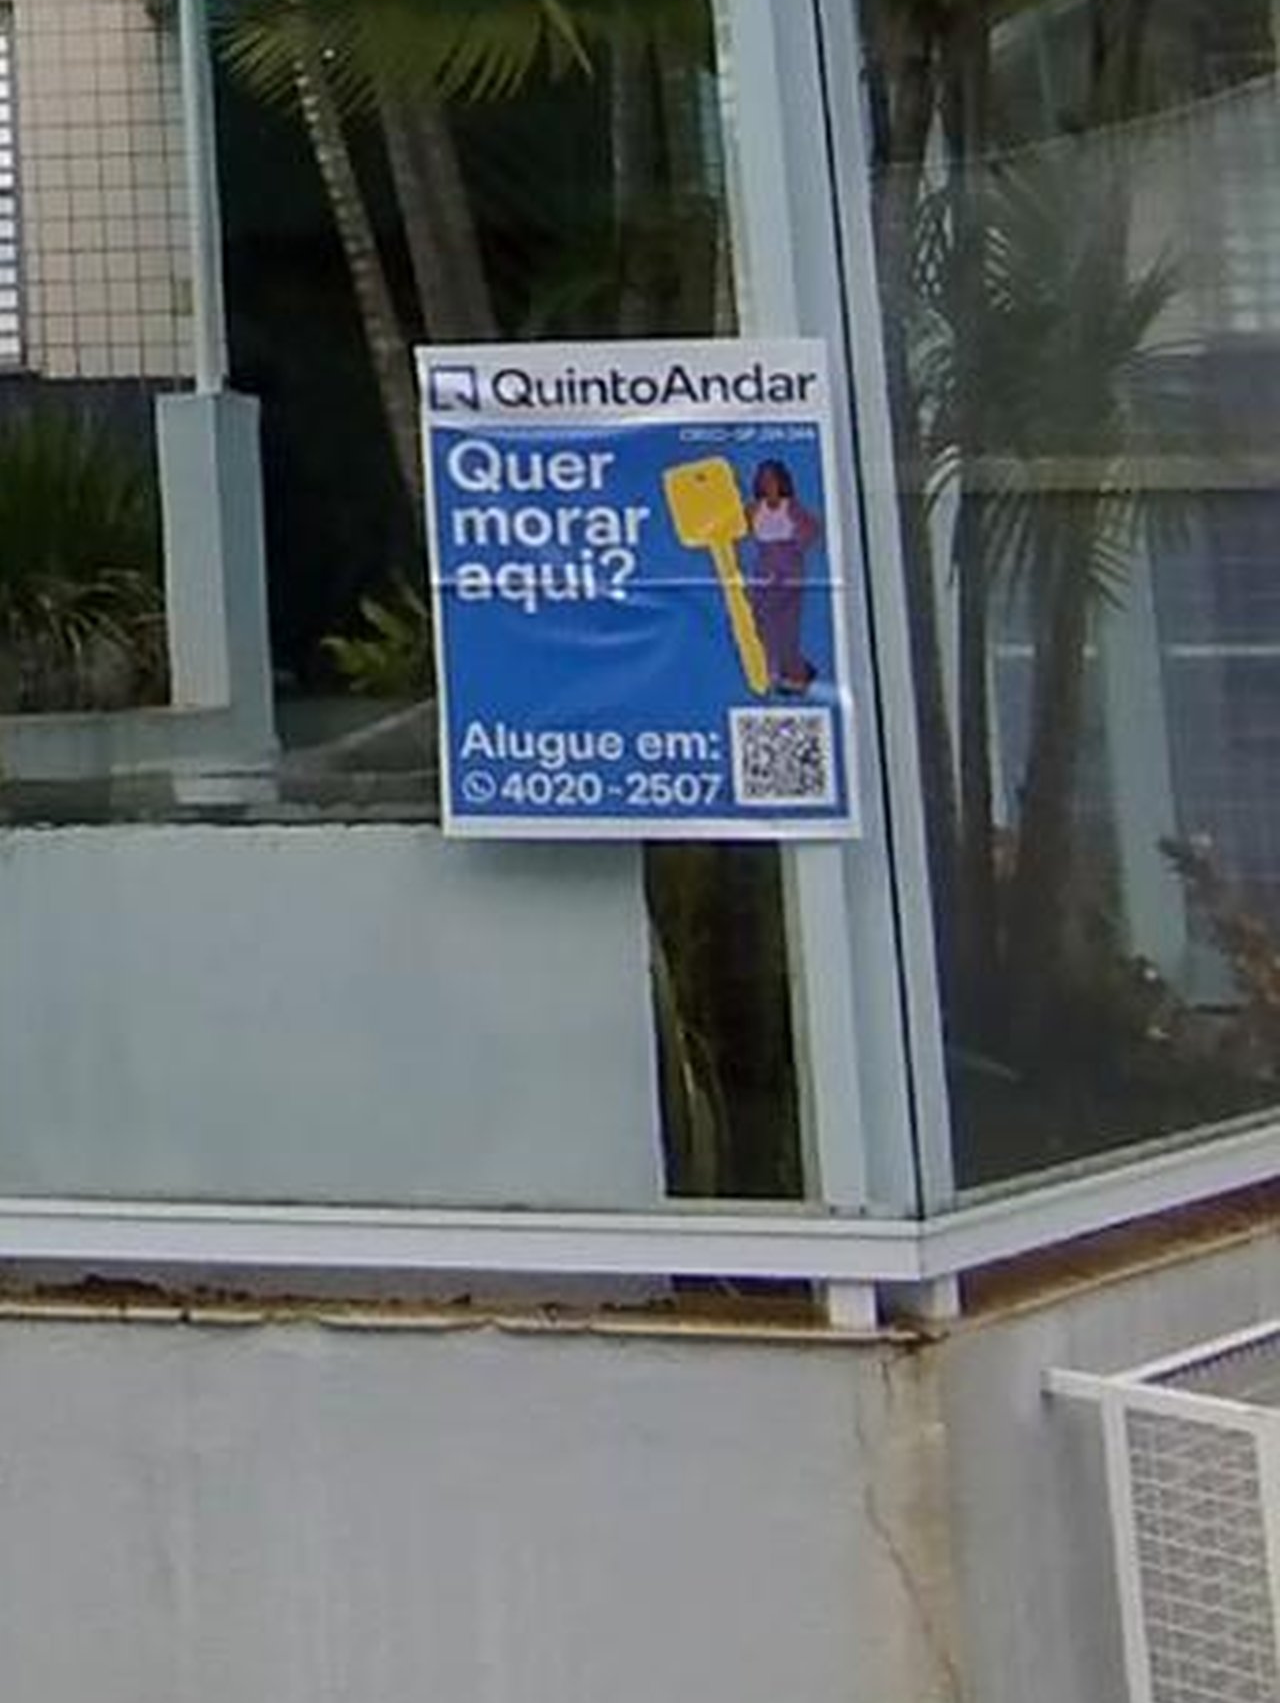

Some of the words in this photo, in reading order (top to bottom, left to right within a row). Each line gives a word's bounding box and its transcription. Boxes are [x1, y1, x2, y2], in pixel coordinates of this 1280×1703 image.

[491, 365, 816, 410] QuintoAndar
[448, 440, 615, 493] Quer
[452, 505, 651, 547] morar
[457, 551, 636, 612] aqui?
[460, 721, 624, 768] Alugue
[636, 732, 723, 761] em:
[501, 773, 723, 806] 4020-2507
